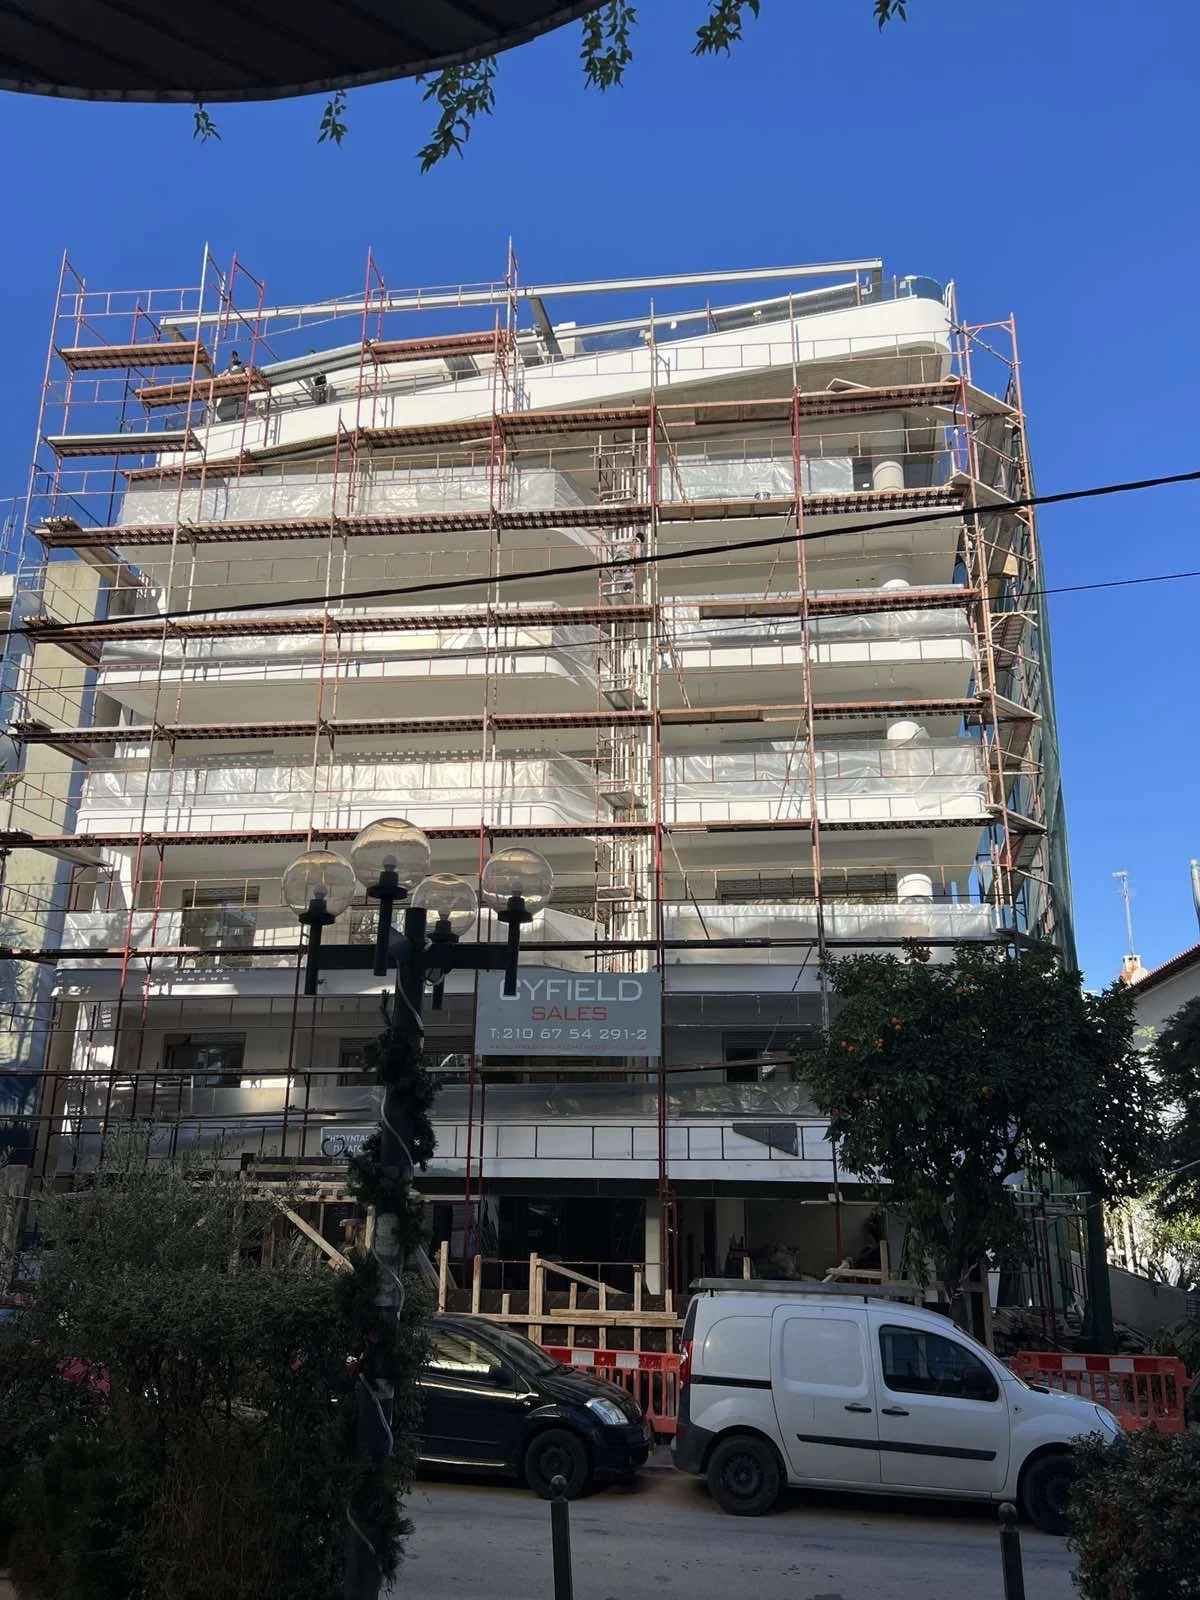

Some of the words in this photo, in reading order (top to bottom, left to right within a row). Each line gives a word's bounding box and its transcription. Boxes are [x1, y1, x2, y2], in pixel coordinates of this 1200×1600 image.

[531, 1006, 608, 1021] SALES
[540, 1028, 562, 1040] 67
[568, 1028, 593, 1040] 54
[599, 1028, 648, 1040] 291-2
